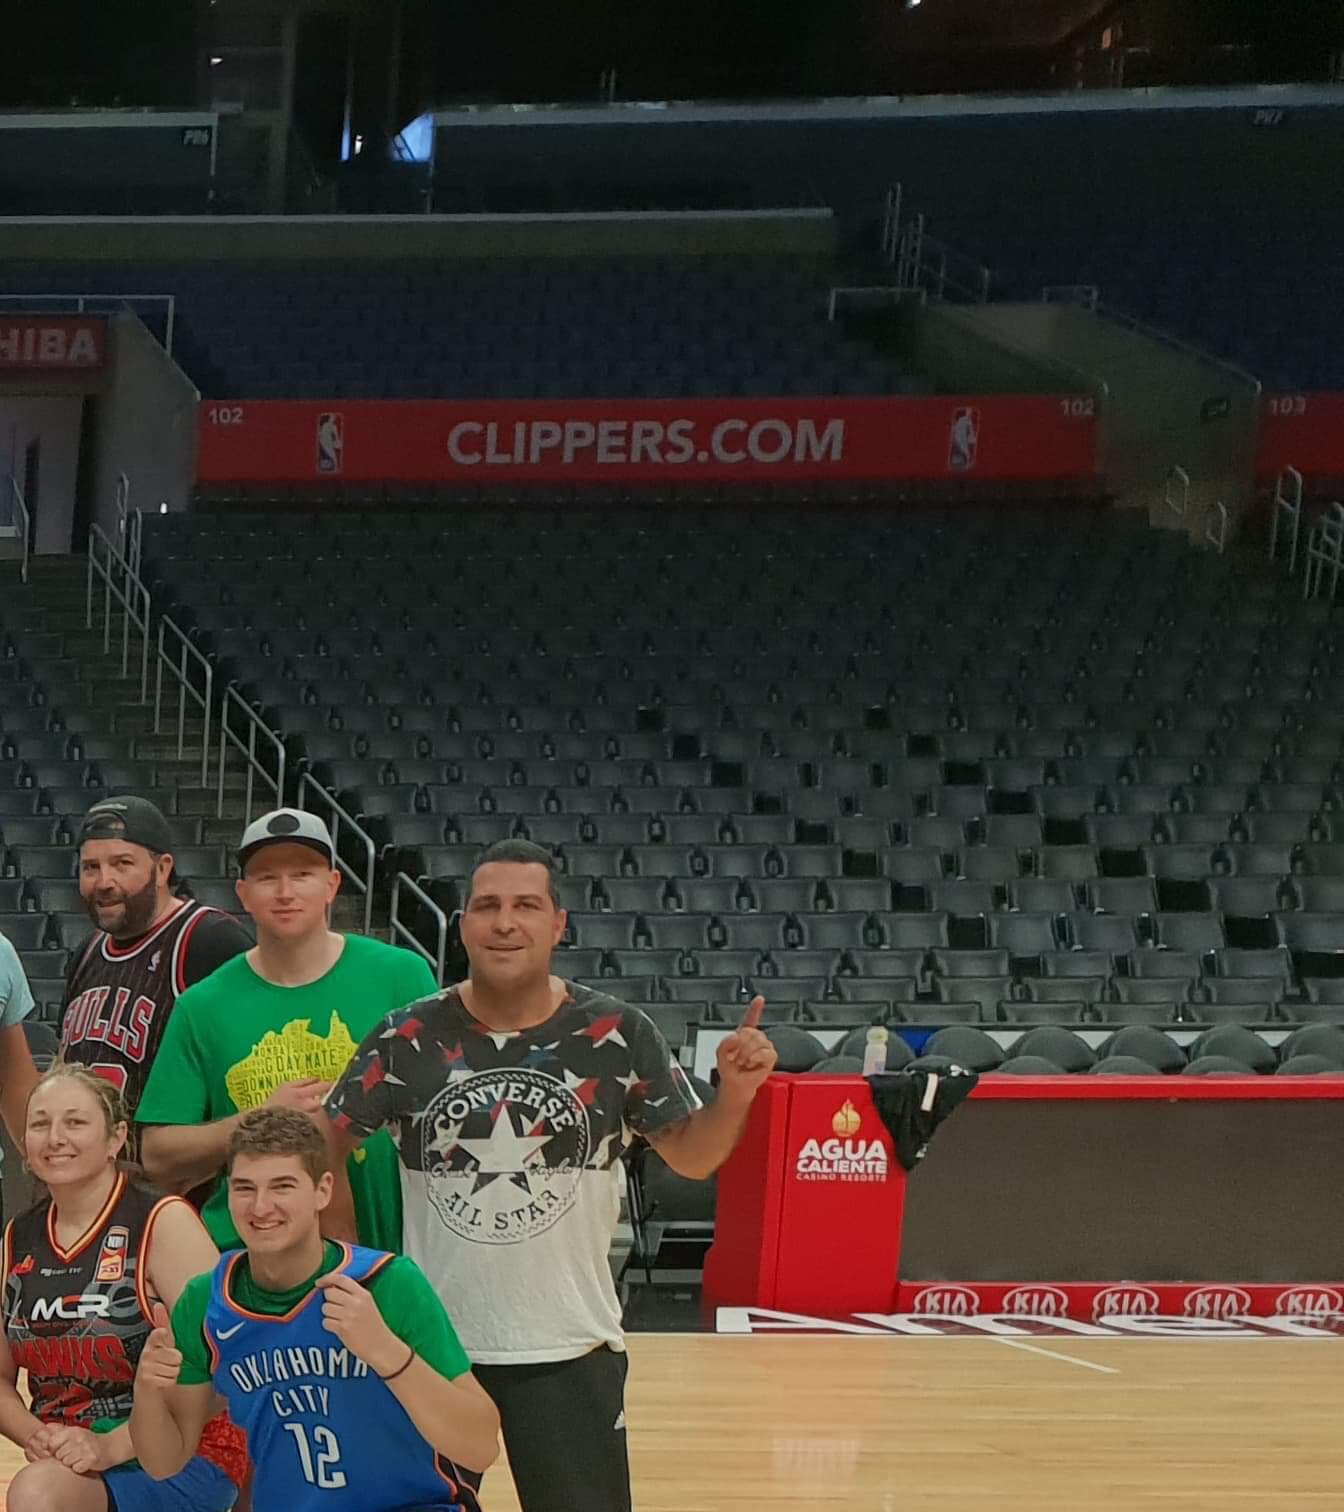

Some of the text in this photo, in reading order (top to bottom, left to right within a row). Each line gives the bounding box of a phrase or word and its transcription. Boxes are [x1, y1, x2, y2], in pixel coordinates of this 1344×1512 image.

[208, 407, 244, 424] 102
[1060, 399, 1095, 416] 102
[447, 418, 845, 465] CLIPPERS.COM
[433, 1079, 575, 1133] CONVERSE
[798, 1138, 888, 1160] AGUA
[796, 1158, 888, 1174] CALIENTE
[494, 1188, 560, 1231] STAR
[31, 1294, 111, 1321] MCR
[925, 1293, 968, 1314] KIA
[1014, 1293, 1057, 1314] KIA
[1104, 1293, 1149, 1315] KIA
[1195, 1293, 1240, 1315] KIA
[1287, 1294, 1331, 1314] KIA
[716, 1306, 1344, 1335] Amer
[229, 1346, 369, 1393] OKLAHOMA
[271, 1384, 330, 1417] CITY
[283, 1422, 347, 1489] 12
